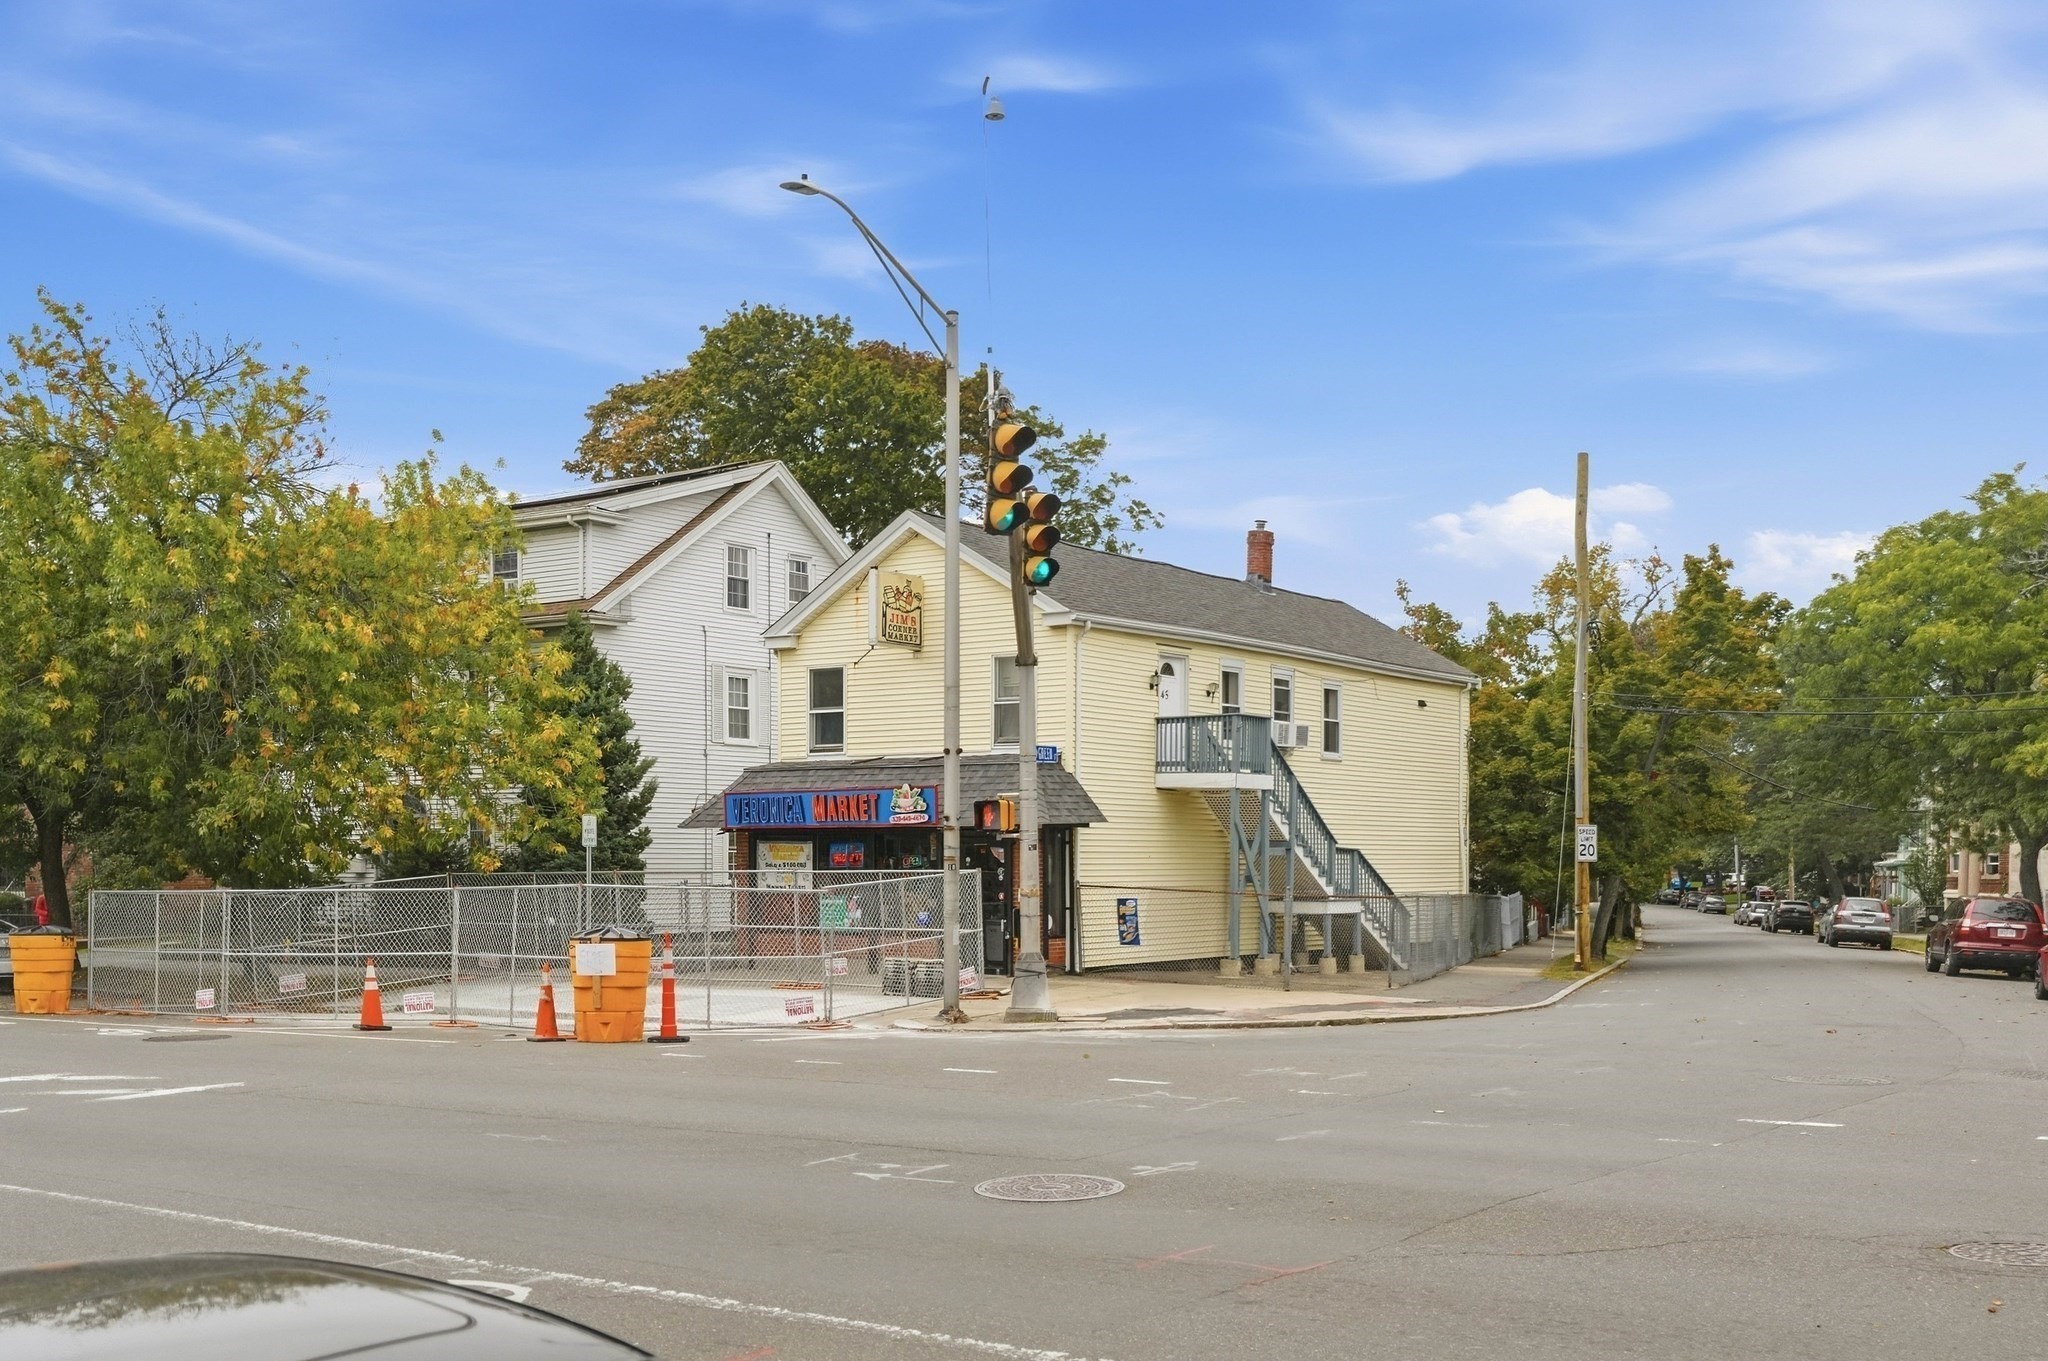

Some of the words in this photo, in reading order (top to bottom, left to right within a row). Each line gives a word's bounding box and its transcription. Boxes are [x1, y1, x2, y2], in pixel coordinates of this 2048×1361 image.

[889, 613, 917, 626] JIM'S
[887, 623, 918, 635] CORNER
[887, 631, 918, 642] MARKET
[1160, 689, 1169, 700] 45
[733, 796, 805, 823] VERONICA
[812, 793, 879, 822] MARKET
[1579, 844, 1595, 857] 20
